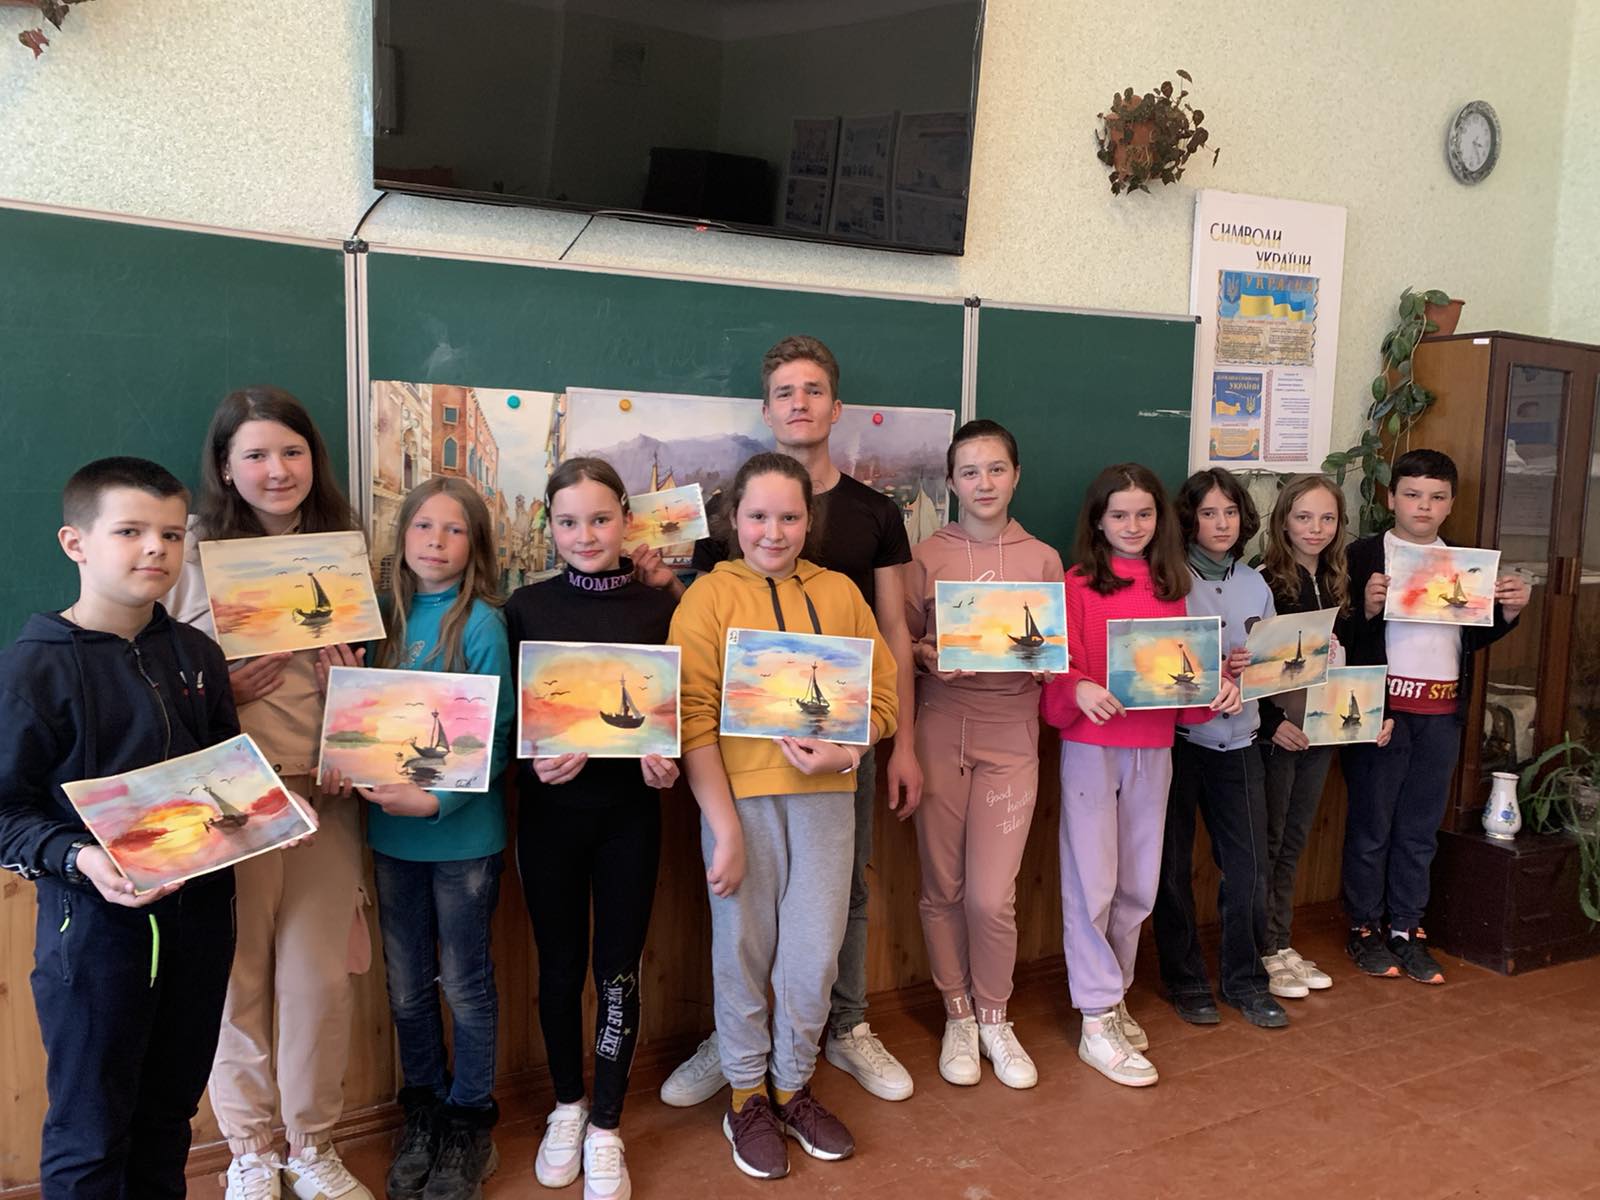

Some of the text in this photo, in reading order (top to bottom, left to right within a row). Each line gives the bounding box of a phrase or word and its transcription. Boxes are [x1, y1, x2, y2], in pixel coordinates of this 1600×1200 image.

[1210, 222, 1282, 249] СИМВОЛИ
[1256, 250, 1312, 273] УКРАЇНИ
[600, 1024, 621, 1056] LIKE
